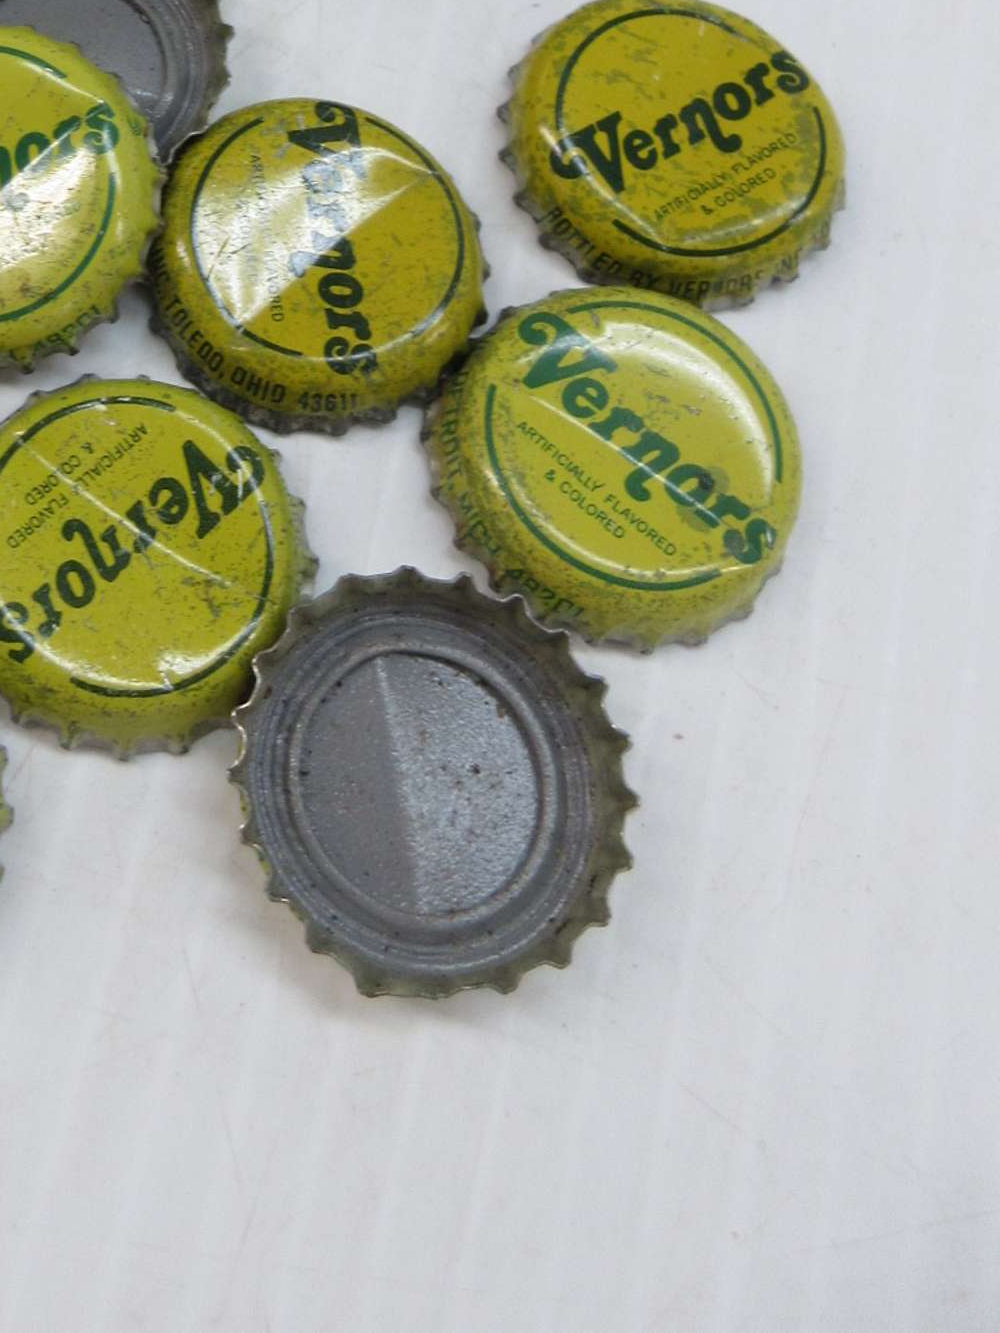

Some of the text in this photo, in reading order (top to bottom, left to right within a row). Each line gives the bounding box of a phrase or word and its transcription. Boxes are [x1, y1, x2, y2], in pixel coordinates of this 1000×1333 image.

[548, 50, 810, 194] Vernors
[653, 131, 797, 221] ARTIFICIALLY FLAVORED
[700, 167, 777, 217] & COLORED
[286, 100, 379, 376] Vernors
[164, 293, 227, 380] TOLEDO,
[230, 366, 287, 404] OHIO
[299, 391, 358, 413] 43611
[83, 442, 95, 454] &
[516, 420, 677, 557] ARTIFICIALLY FLAVORED
[517, 311, 777, 565] Vernors
[6, 493, 68, 549] FLAVORED
[544, 468, 626, 540] & COLORED
